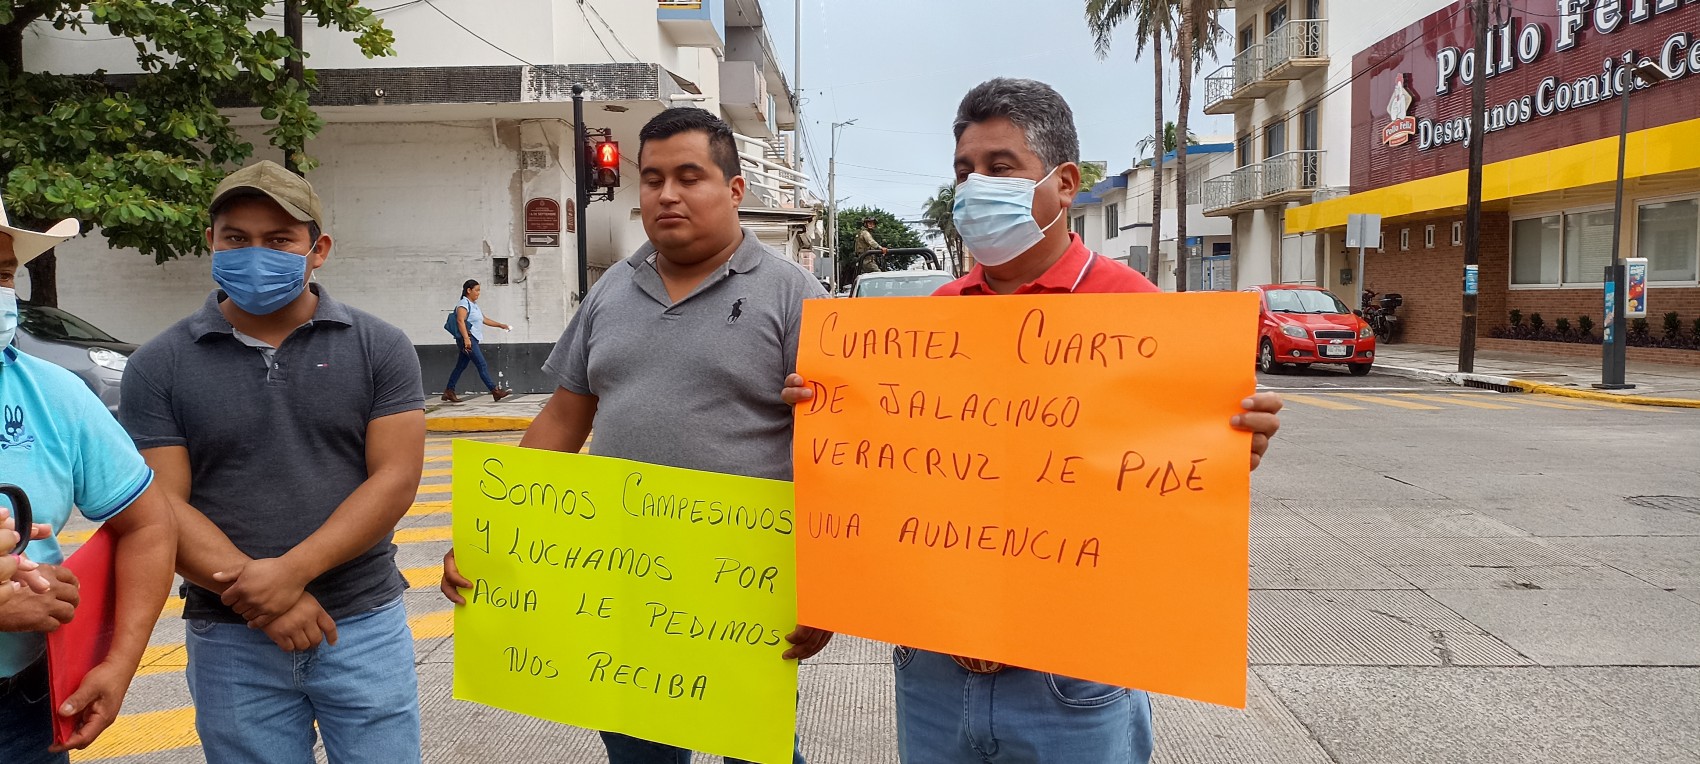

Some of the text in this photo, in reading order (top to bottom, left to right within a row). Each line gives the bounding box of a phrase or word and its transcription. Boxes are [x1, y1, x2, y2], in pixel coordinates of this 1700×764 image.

[1435, 17, 1541, 96] Pollo
[820, 308, 1158, 367] CUARTEL CUARTO
[803, 380, 1080, 428] DE JALACINGO
[479, 458, 793, 535] SOMOS CAMPESINOS
[812, 438, 1208, 497] VERACRUZ LE PIDE
[470, 518, 779, 594] Y LUCHAMOS POR
[809, 512, 1101, 568] UNA AUDIENCIA
[472, 578, 781, 647] AGUA LE PEDIMOS
[503, 646, 708, 701] NOS RECIBA
